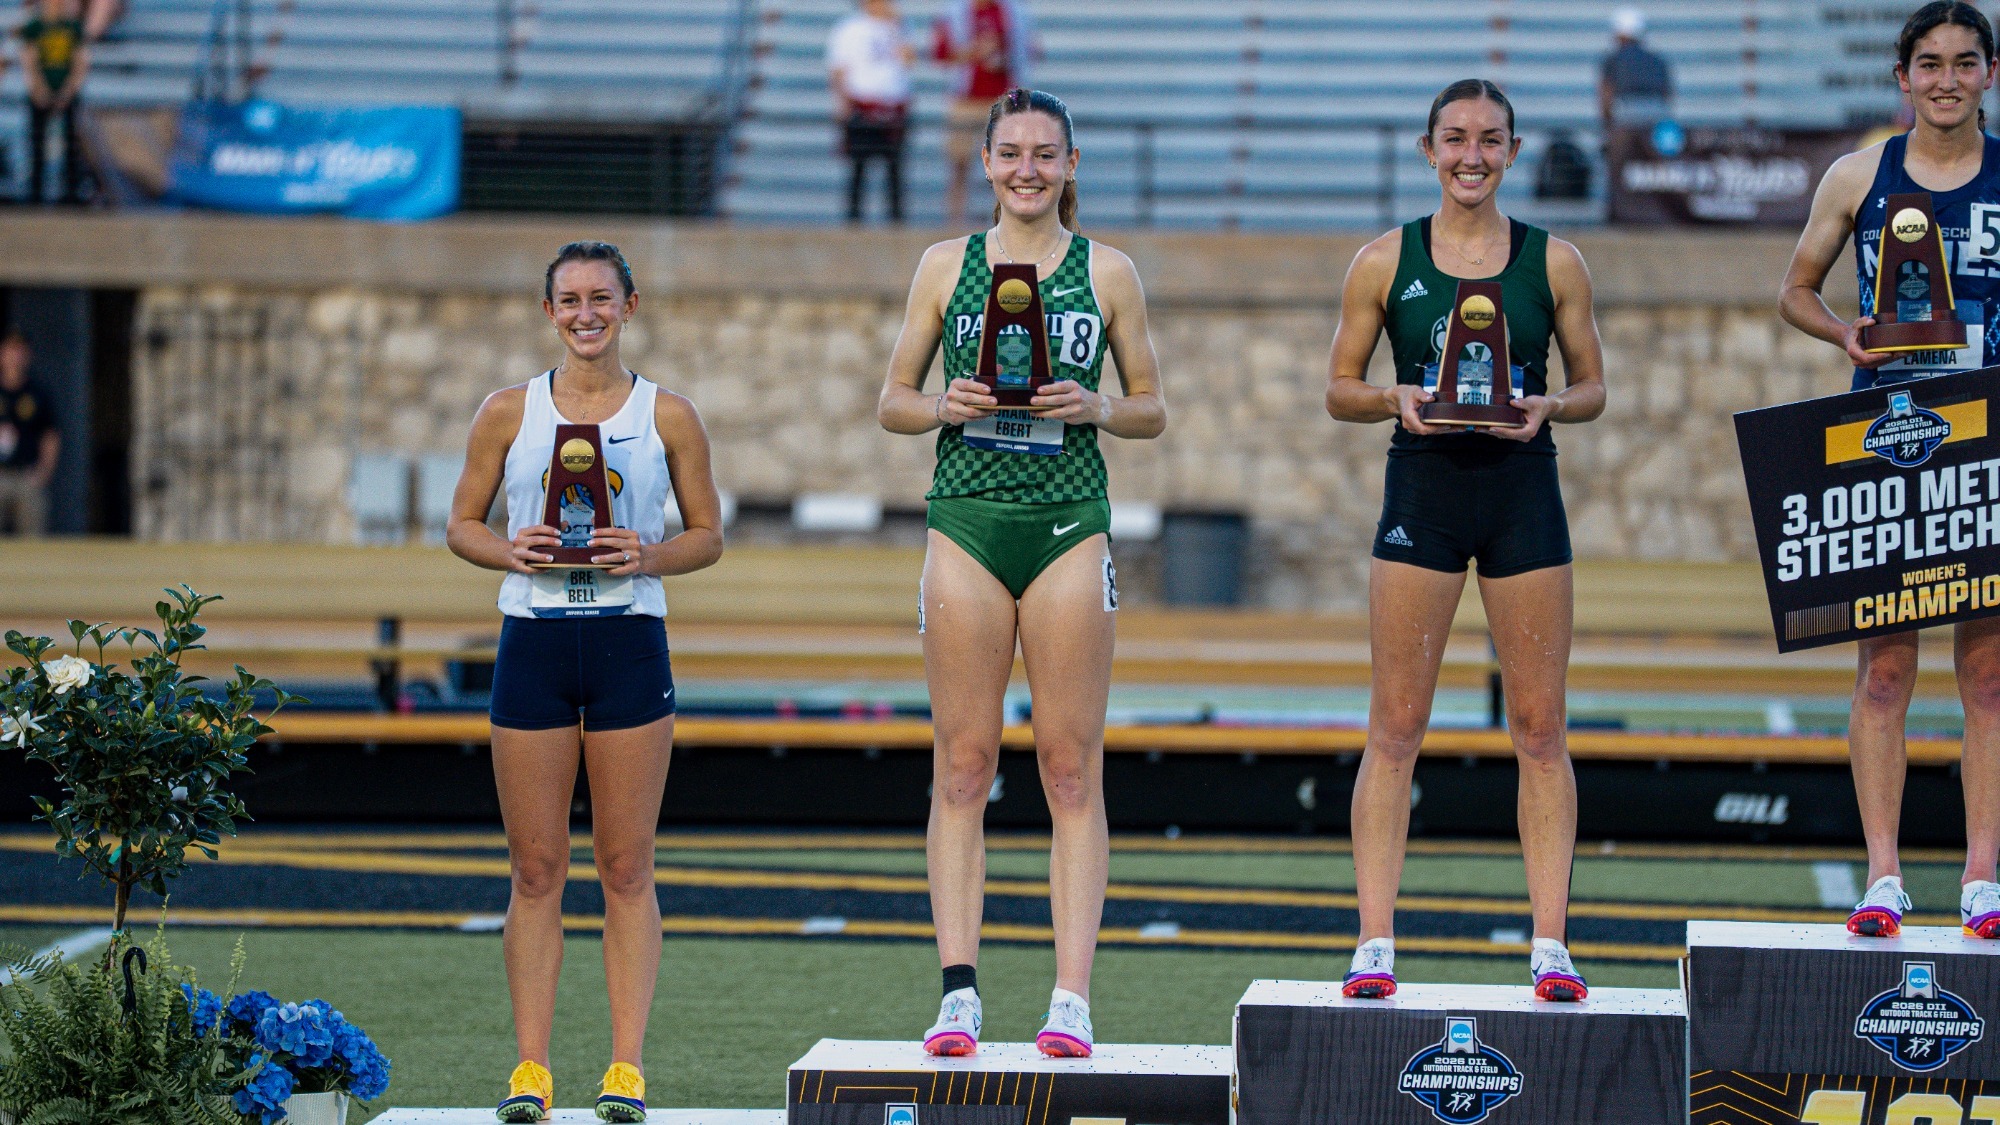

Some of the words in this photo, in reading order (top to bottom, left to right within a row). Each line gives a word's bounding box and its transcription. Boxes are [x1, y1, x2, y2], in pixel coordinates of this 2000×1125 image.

[1896, 225, 1927, 235] NCAA
[1940, 227, 1971, 239] SCH
[1001, 295, 1030, 305] NCAA
[1401, 289, 1428, 301] adidas
[1070, 317, 1093, 364] 8
[1904, 351, 1957, 365] LAMENA
[1909, 416, 1924, 424] DII
[995, 421, 1032, 438] EBERT
[1878, 426, 1900, 436] OUTDOOR
[1900, 424, 1914, 432] TRACK
[1919, 420, 1933, 428] FIELD
[1865, 424, 1949, 449] CHAMPIONSHIPS
[1783, 476, 1906, 537] 3,000
[1920, 458, 2000, 512] MET
[1384, 536, 1413, 546] adidas
[1777, 503, 2000, 582] STEEPLECH
[570, 571, 593, 585] BRE
[1903, 562, 1966, 586] WOMEN'S
[568, 588, 597, 603] BELL
[1855, 574, 2000, 629] CHAMPIO
[1714, 793, 1789, 825] GILL
[1891, 1002, 1924, 1010] 2026
[1926, 1003, 1947, 1011] DII
[1880, 1009, 1911, 1018] OUTDOOR
[1911, 1010, 1932, 1018] TRACK
[1933, 1010, 1938, 1018] &
[1939, 1011, 1959, 1019] FIELD
[1859, 1018, 1980, 1037] CHAMPIONSHIPS
[1434, 1057, 1465, 1065] 2026
[1468, 1058, 1487, 1066] DII
[1423, 1064, 1452, 1073] OUTDOOR
[1453, 1065, 1473, 1073] TRACK
[1474, 1065, 1479, 1073] &
[1480, 1066, 1498, 1074] FIELD
[1402, 1073, 1519, 1091] CHAMPIONSHIPS
